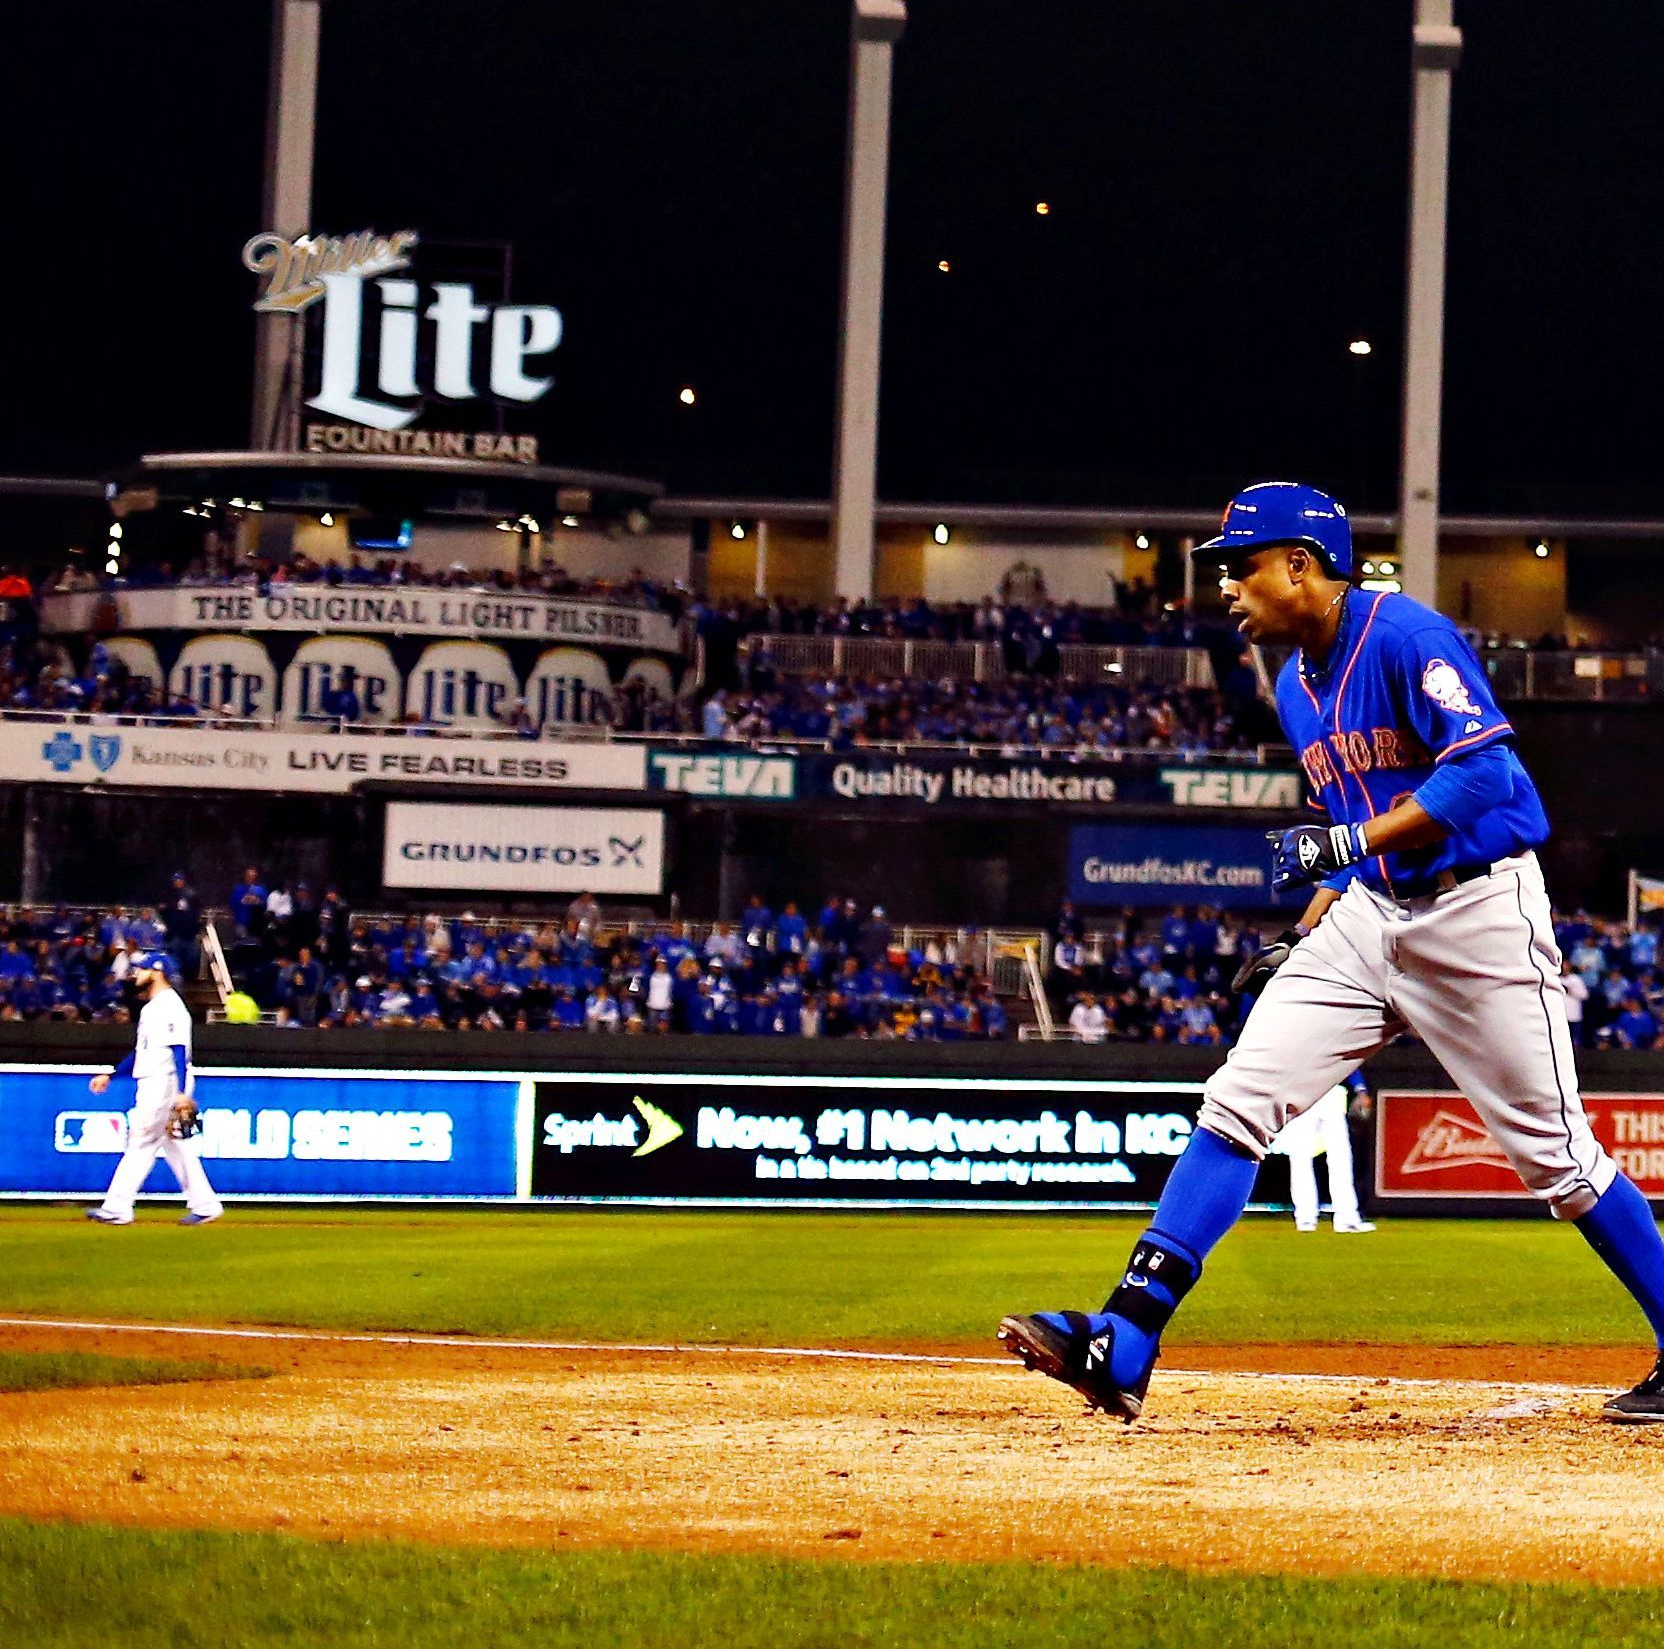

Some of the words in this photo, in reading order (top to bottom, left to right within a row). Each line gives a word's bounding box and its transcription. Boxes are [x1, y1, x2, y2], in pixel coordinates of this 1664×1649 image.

[304, 271, 564, 431] Lite
[306, 424, 468, 457] FOUNTAIN
[472, 431, 538, 462] BAR
[192, 596, 254, 620] THE
[264, 596, 425, 625] ORIGINAL
[440, 602, 536, 631] LIGHT
[132, 746, 215, 768] Kansas
[223, 748, 269, 773] City
[288, 750, 368, 773] LIVE
[380, 753, 568, 779] FEARLESS
[654, 754, 795, 798] TEVA
[832, 763, 941, 803] Quality
[951, 766, 1115, 803] Healthcare
[1162, 770, 1298, 808] TEVA
[401, 841, 601, 867] GRUNDFOS
[1083, 858, 1264, 889] GrundfosKC.com
[292, 1109, 453, 1161] SERIES
[543, 1113, 638, 1154] Sprint
[696, 1107, 811, 1154] Now,
[816, 1109, 866, 1151] #1
[870, 1109, 1072, 1152] Network
[1075, 1110, 1120, 1152] in
[1125, 1114, 1192, 1155] KC
